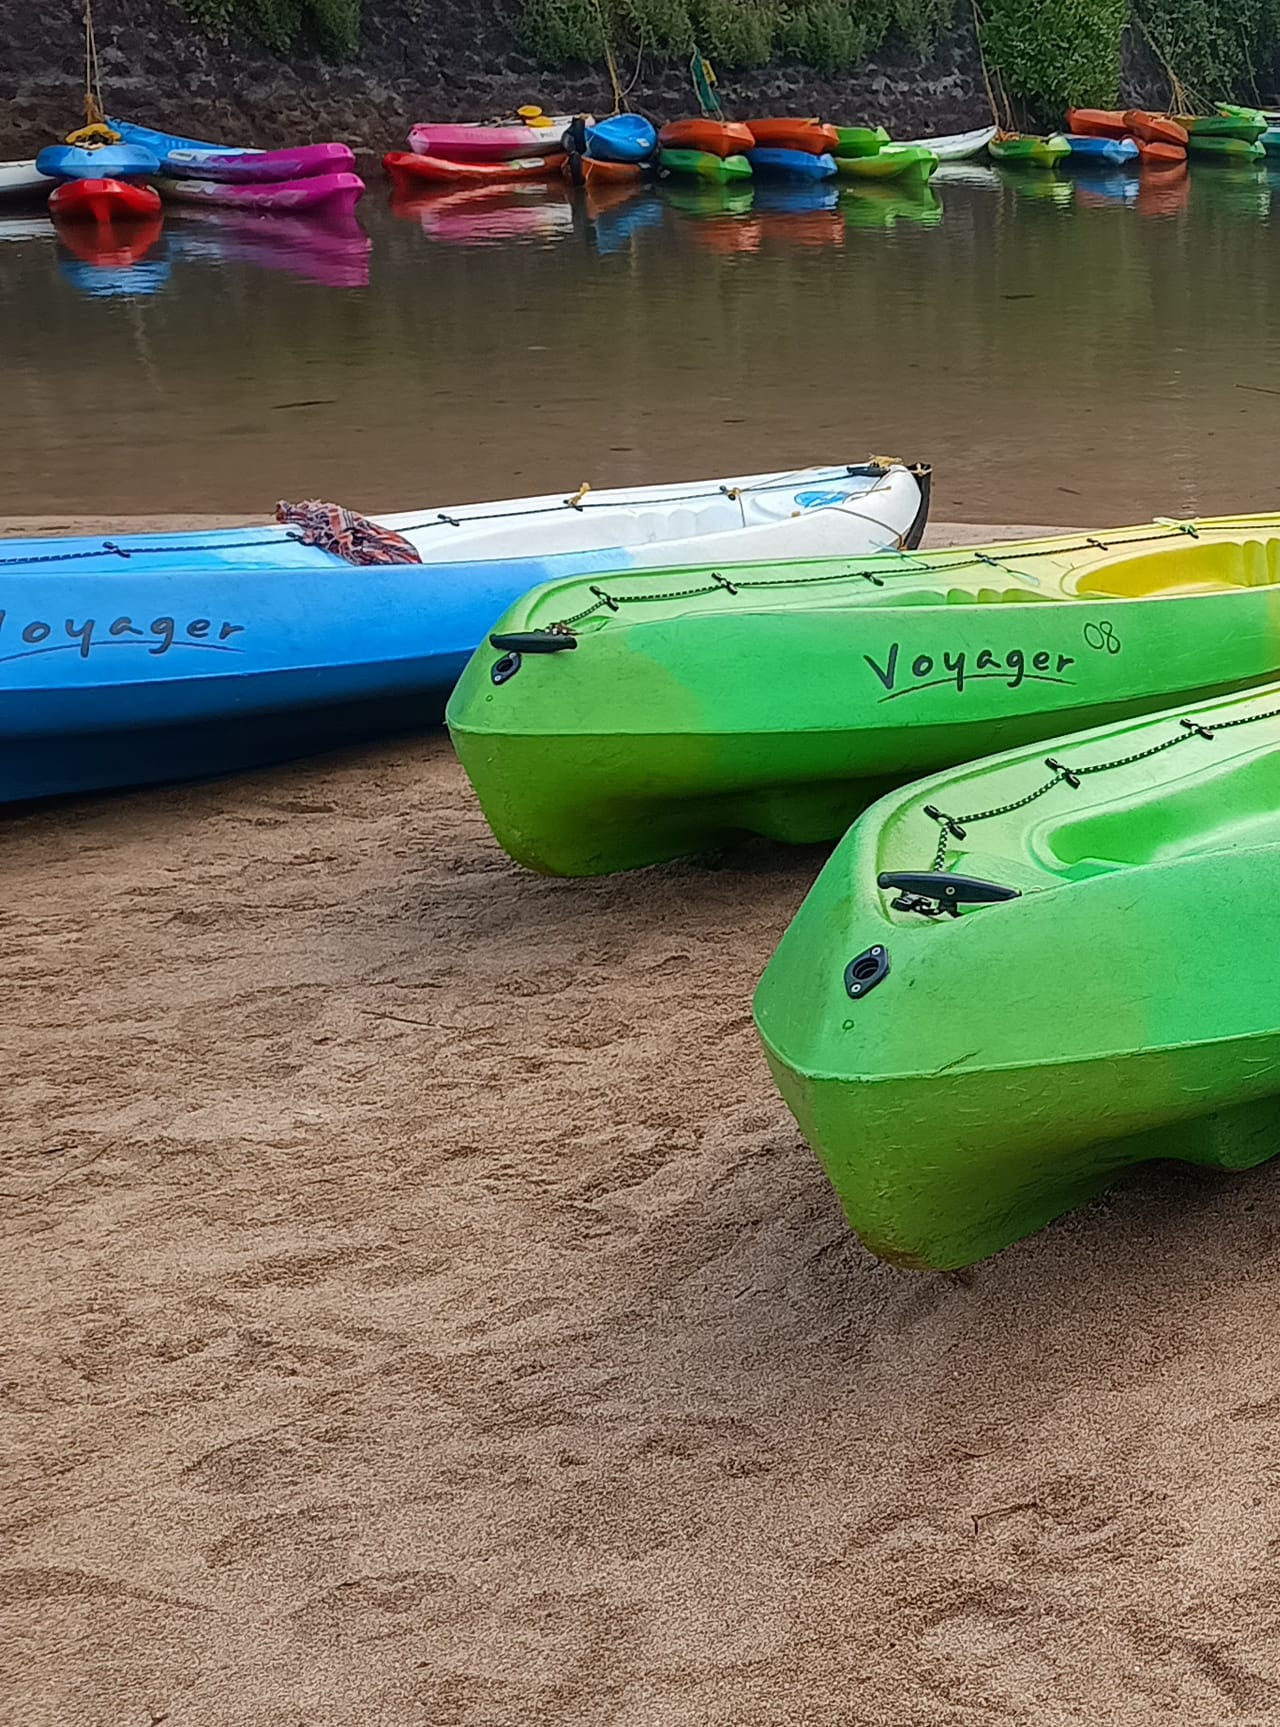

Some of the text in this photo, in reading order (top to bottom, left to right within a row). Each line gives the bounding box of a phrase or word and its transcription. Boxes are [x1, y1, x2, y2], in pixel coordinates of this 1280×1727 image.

[0, 609, 245, 658] oyager
[1083, 621, 1121, 654] 08
[863, 642, 1075, 692] Voyager
